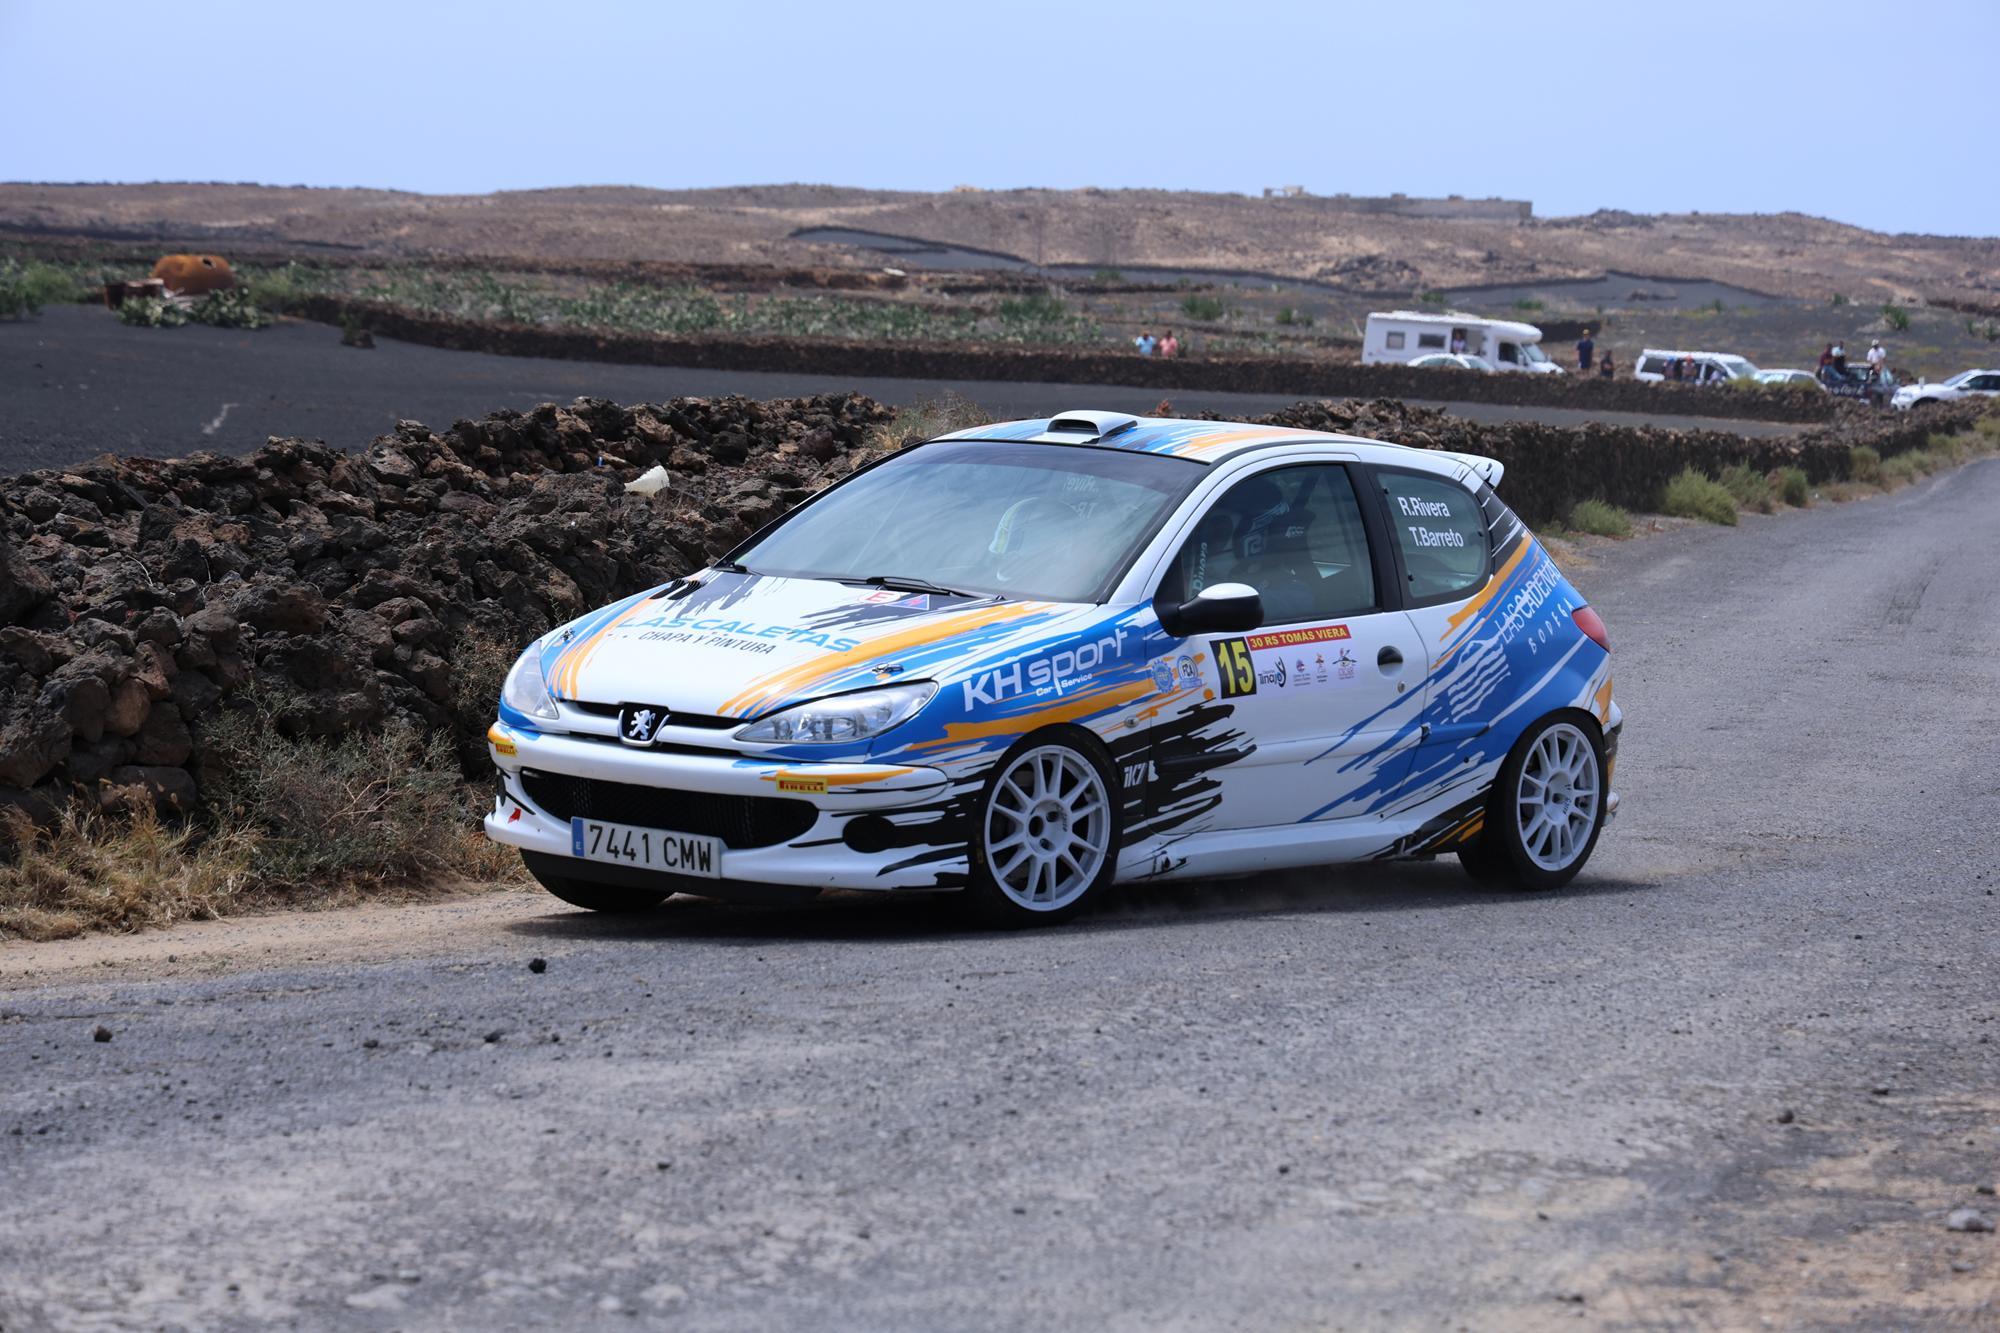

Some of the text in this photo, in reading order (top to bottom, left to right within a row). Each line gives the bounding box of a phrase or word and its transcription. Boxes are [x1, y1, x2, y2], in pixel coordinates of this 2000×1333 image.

[1398, 496, 1450, 518] R.Rivera
[1409, 526, 1464, 548] T.Barreto
[617, 616, 862, 653] LAS CALETAS
[638, 630, 777, 655] CHAPA Y PINTURA
[1251, 637, 1264, 649] 30
[1265, 635, 1280, 646] RS
[1316, 628, 1347, 640] VIERA
[962, 628, 1128, 712] KH sport
[1218, 641, 1255, 694] 15
[1036, 672, 1093, 697] Car Service
[780, 779, 825, 792] PIRELLI
[589, 825, 711, 873] 7441 CMW
